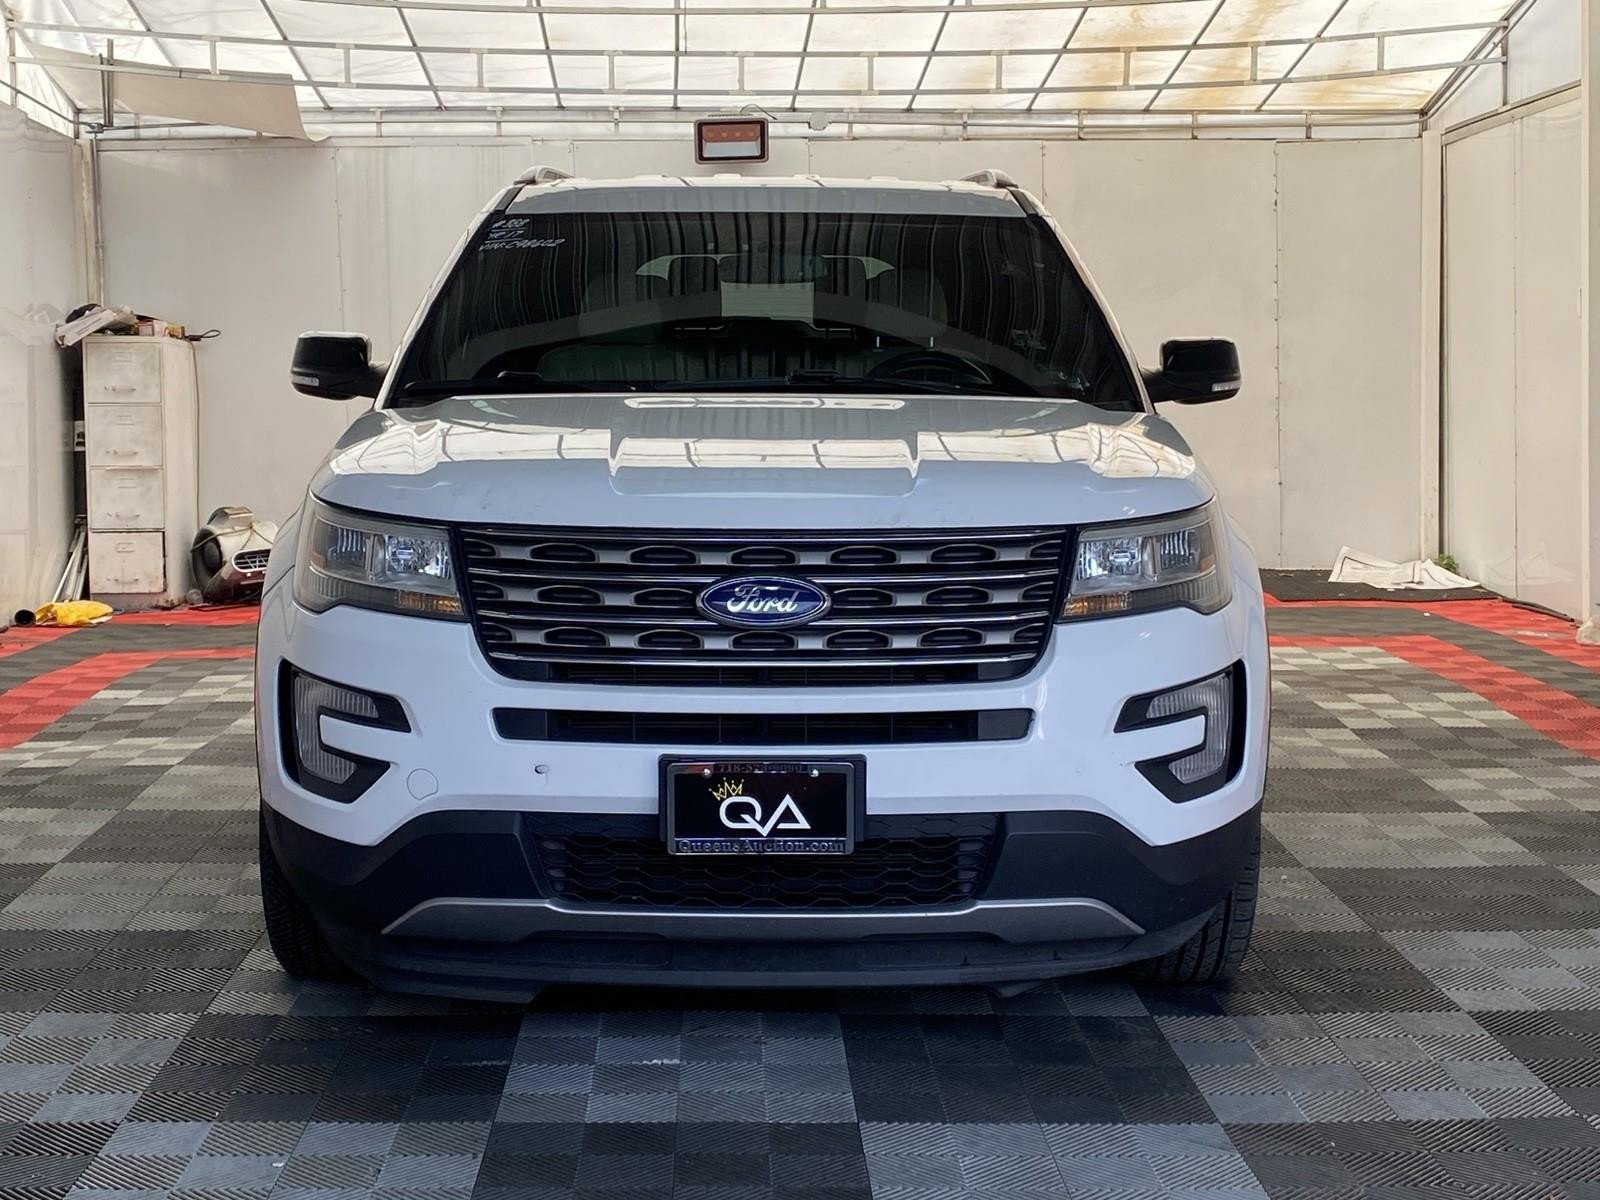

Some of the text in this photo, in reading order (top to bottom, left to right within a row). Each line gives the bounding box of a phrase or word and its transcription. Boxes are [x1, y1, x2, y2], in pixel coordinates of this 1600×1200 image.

[726, 583, 800, 613] Ford
[719, 793, 812, 837] QA
[678, 839, 845, 853] QueensAuction.com
